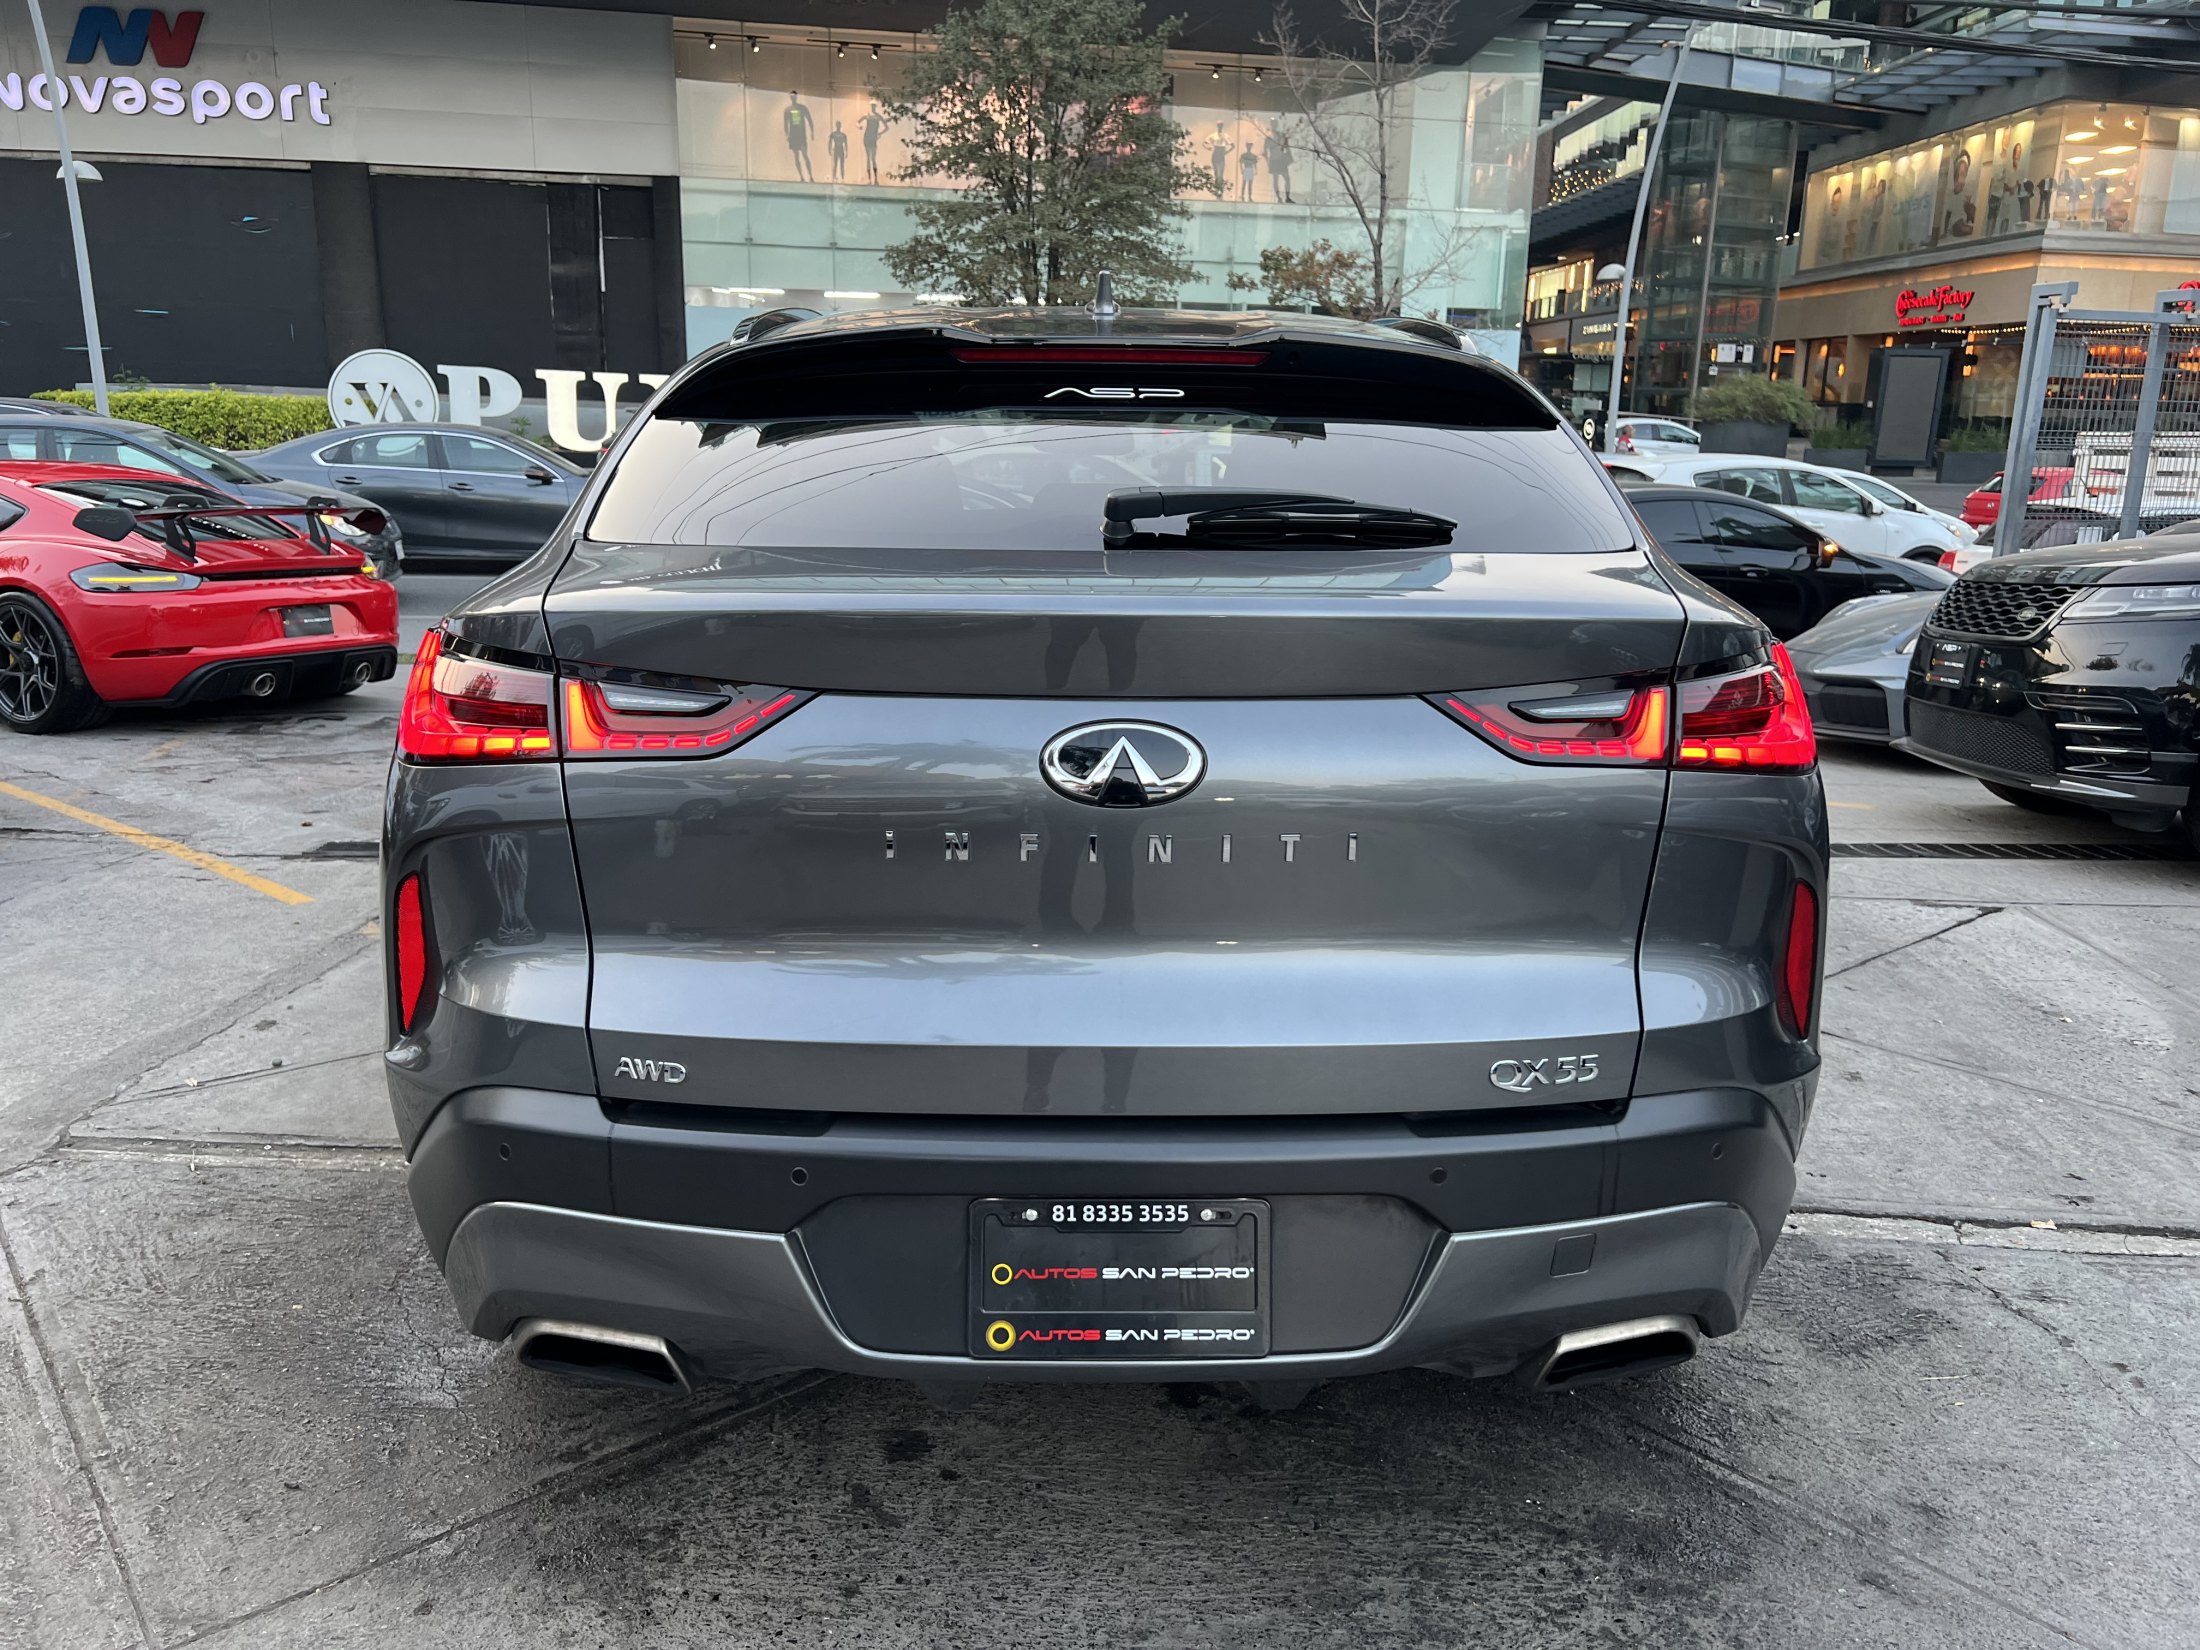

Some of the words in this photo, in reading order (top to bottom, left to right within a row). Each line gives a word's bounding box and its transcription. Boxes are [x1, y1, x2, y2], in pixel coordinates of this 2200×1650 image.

[885, 830, 1359, 863] INFINITI
[614, 1056, 686, 1084] AWD
[1052, 1204, 1077, 1222] 81
[1082, 1204, 1133, 1222] 8335
[1139, 1204, 1189, 1222] 3535
[1014, 1267, 1098, 1279] AUTOS
[1102, 1267, 1156, 1279] SAN
[1018, 1329, 1101, 1341] AUTOS
[1105, 1329, 1158, 1341] SAN
